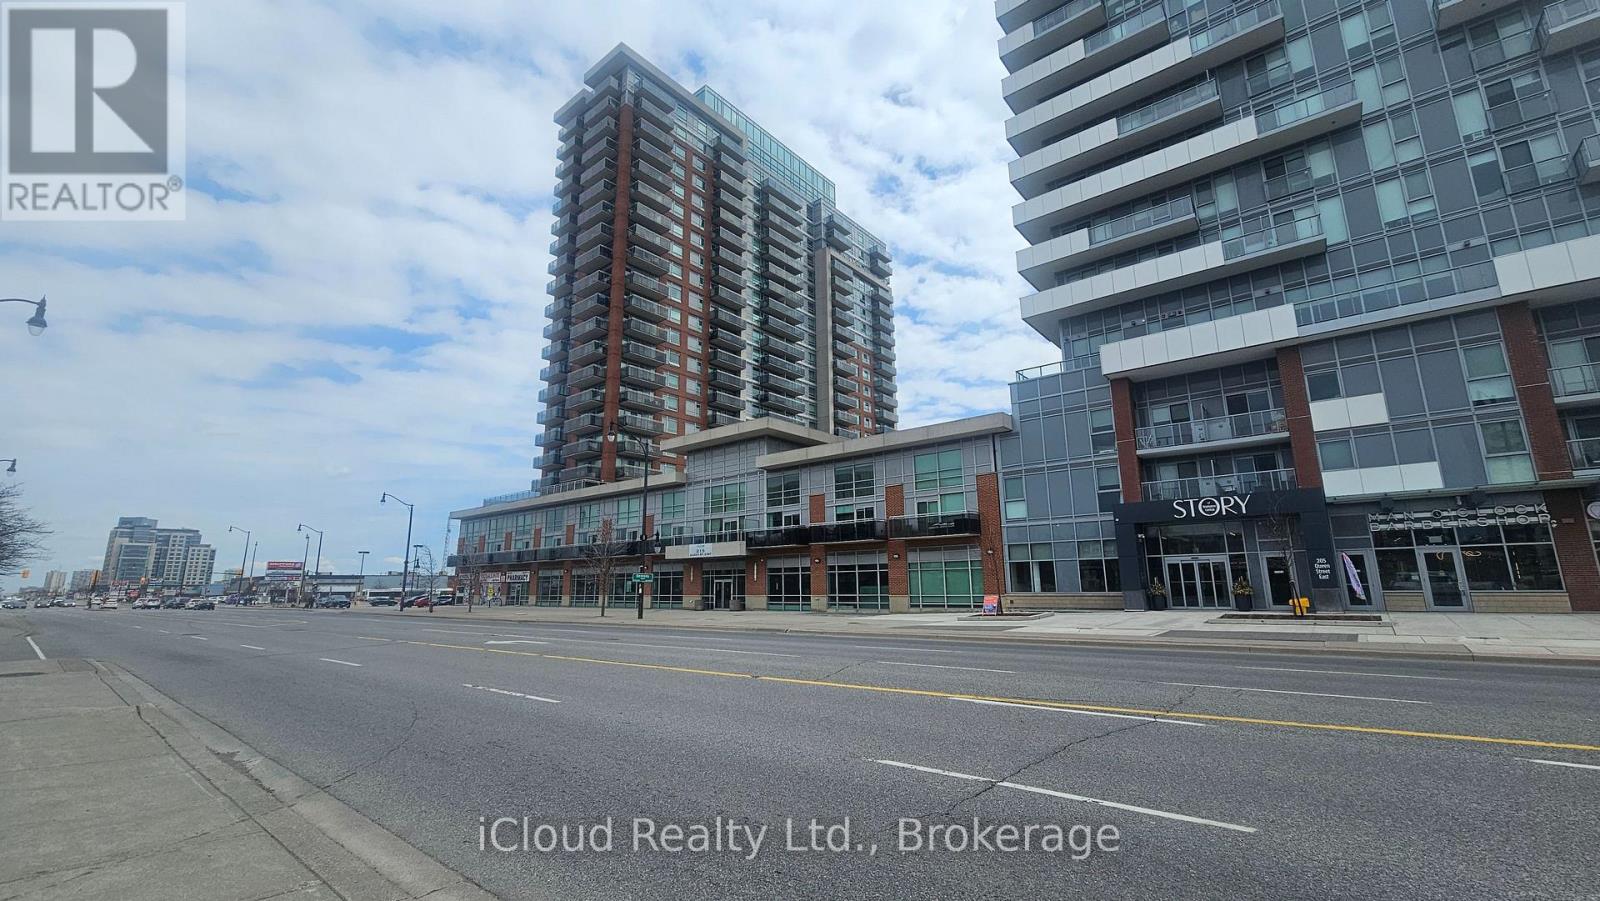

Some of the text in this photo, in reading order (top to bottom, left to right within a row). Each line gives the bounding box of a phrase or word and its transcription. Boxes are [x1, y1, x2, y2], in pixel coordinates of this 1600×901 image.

[1173, 494, 1251, 519] STORY
[1368, 502, 1549, 522] MAN O'CLOCK
[1370, 513, 1551, 532] BARBERSHOP
